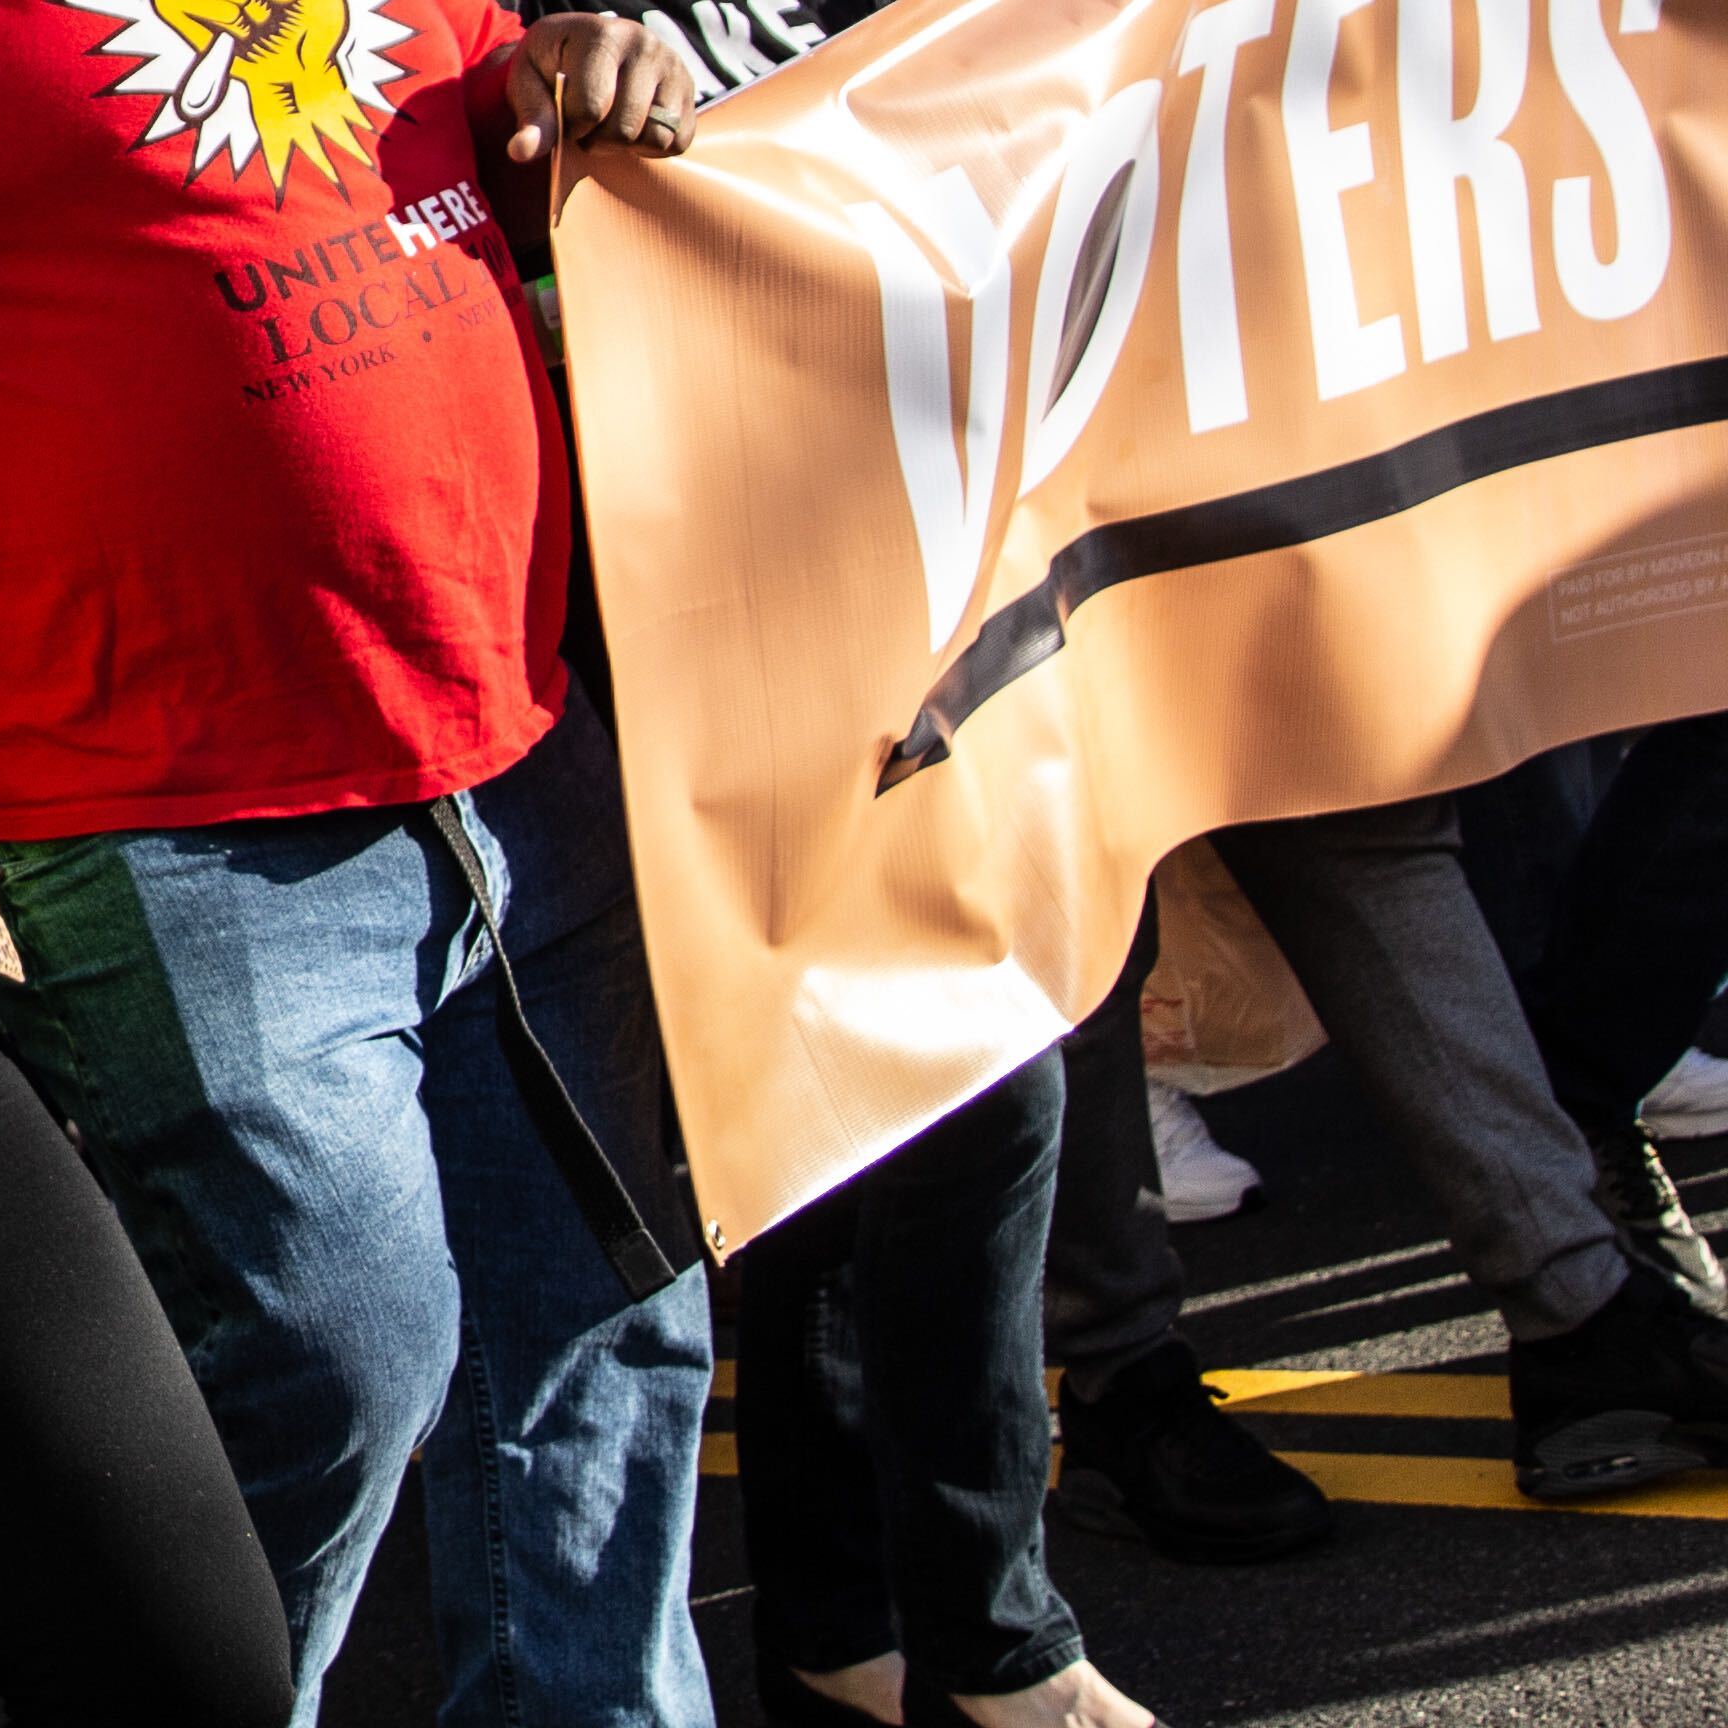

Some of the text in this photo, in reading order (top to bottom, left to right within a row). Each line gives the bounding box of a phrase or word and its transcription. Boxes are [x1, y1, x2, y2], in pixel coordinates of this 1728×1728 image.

[256, 260, 468, 365] LOCAL
[242, 368, 312, 404] NEW
[321, 343, 398, 385] YORK
